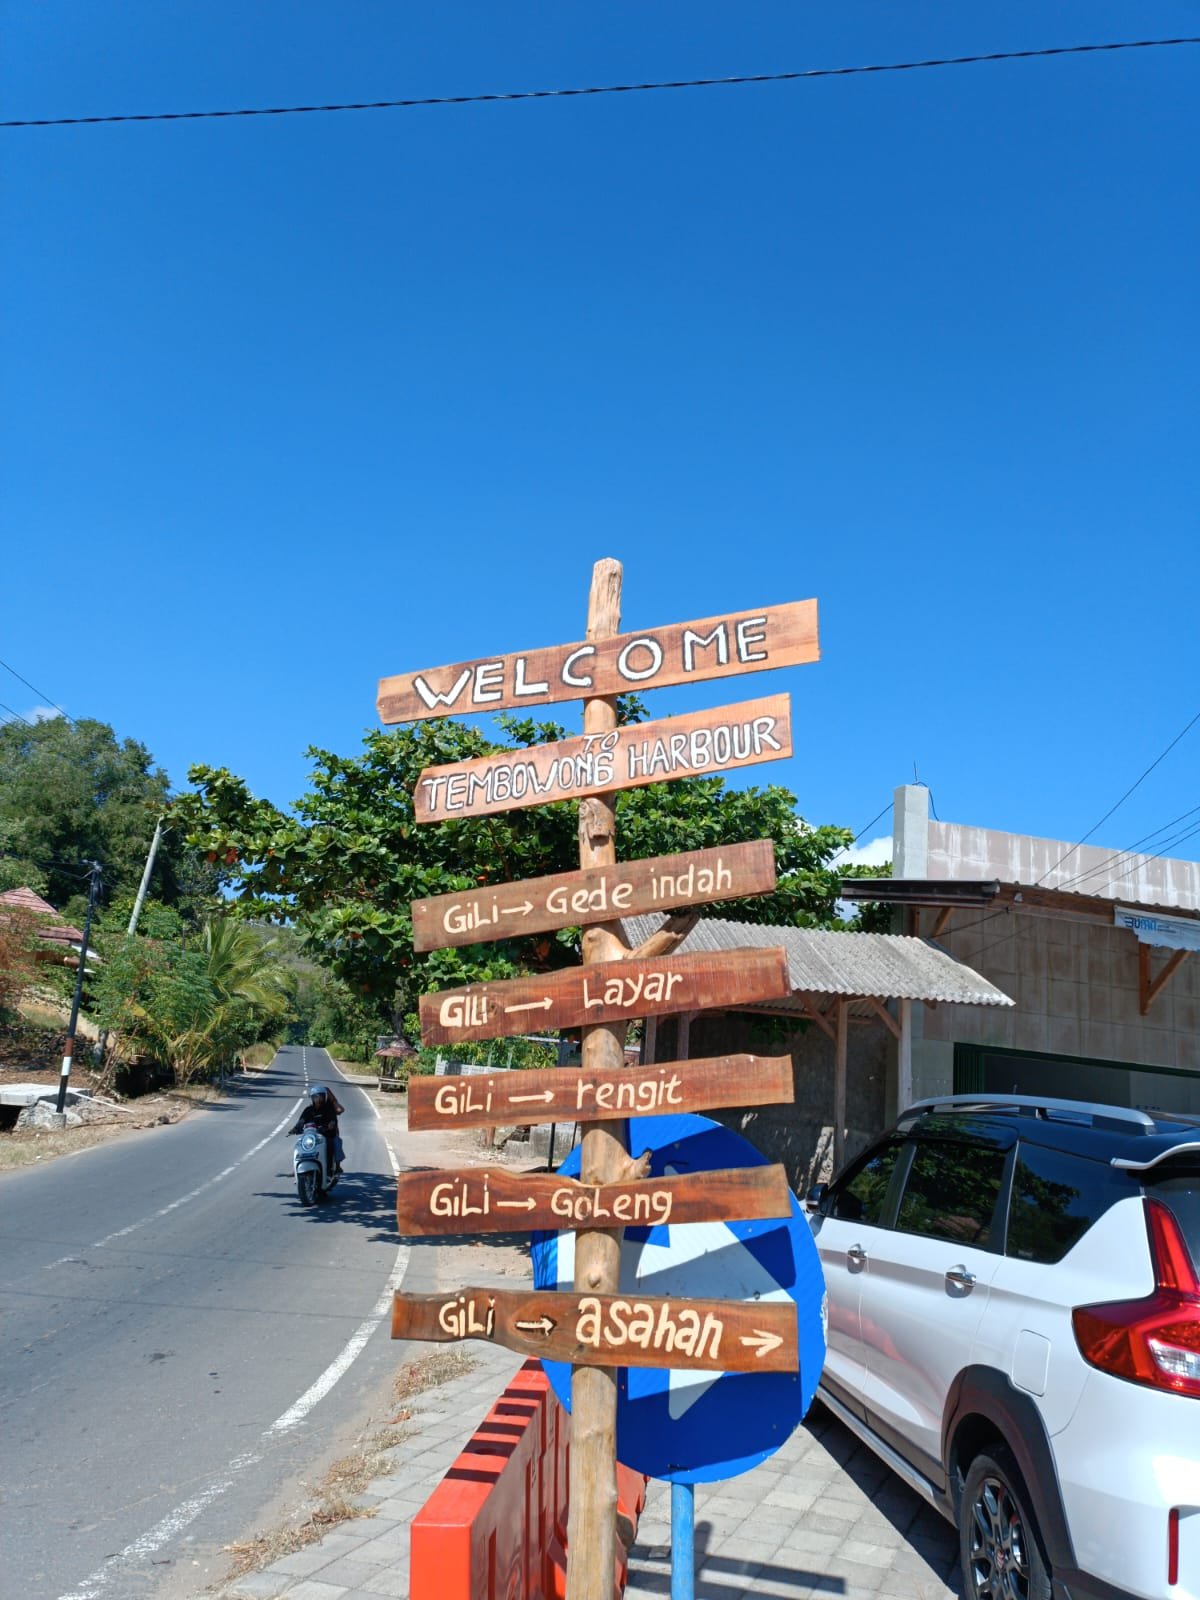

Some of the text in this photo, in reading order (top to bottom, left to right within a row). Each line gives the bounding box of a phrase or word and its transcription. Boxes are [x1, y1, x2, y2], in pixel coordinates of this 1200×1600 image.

[413, 616, 768, 709] WELCOME
[422, 715, 782, 812] TEMBOWONG HARBOUR
[583, 731, 620, 752] TO
[546, 877, 634, 915] Gede
[650, 858, 732, 901] indah
[583, 971, 683, 1009] Layar
[576, 1069, 683, 1112] rengit
[575, 1297, 724, 1360] asahan
